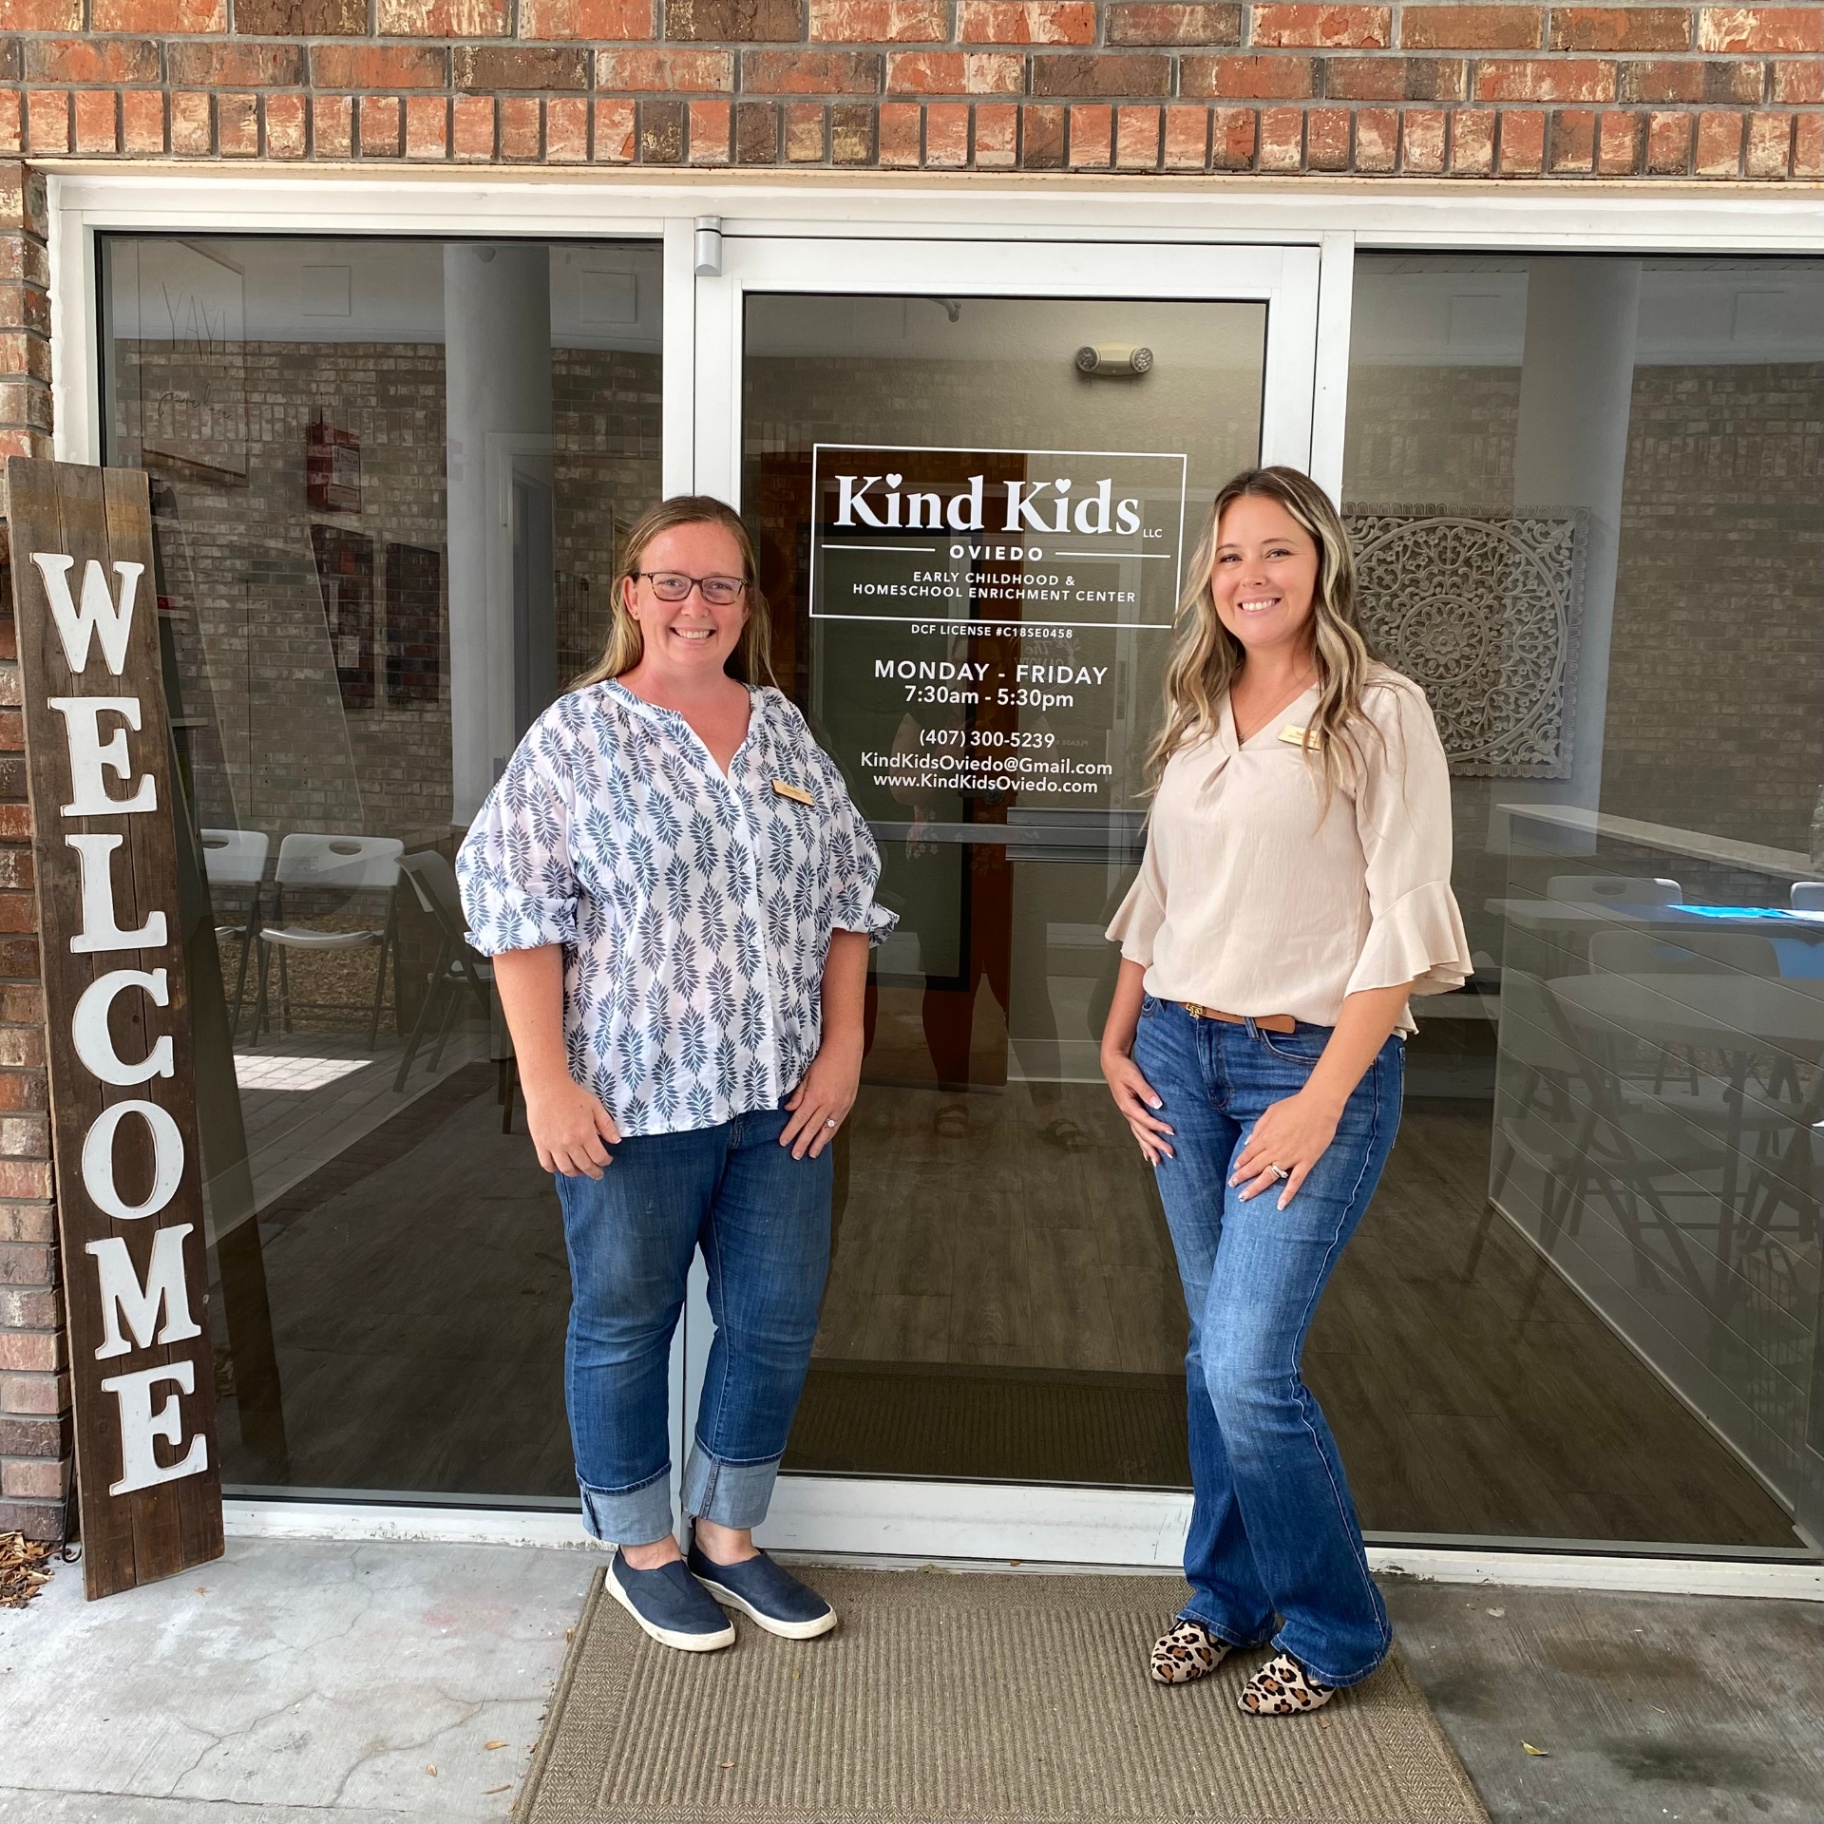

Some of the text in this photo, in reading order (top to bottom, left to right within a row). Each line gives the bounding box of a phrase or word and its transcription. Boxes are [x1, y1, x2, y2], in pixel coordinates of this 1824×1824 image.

[833, 473, 1163, 538] Kind Kids LLC
[949, 544, 1043, 562] OVIEDO
[913, 571, 1075, 586] EARLY CHILDHOOD &
[853, 583, 1135, 603] HOMESCHOOL ENRICHMENT CENTER
[911, 624, 1073, 639] DCF LICENSE #C18SE0458
[875, 659, 990, 681] MONDAY
[1016, 664, 1108, 685] FRIDAY
[904, 685, 979, 704] 7:30am
[997, 688, 1074, 712] 5:30pm
[919, 729, 1056, 749] (407) 300-5239
[861, 751, 1113, 776] KindKidsOviedo@Gmail.com
[873, 773, 1098, 794] www.KindKidsOviedo.com
[29, 551, 208, 1497] WELCOME
